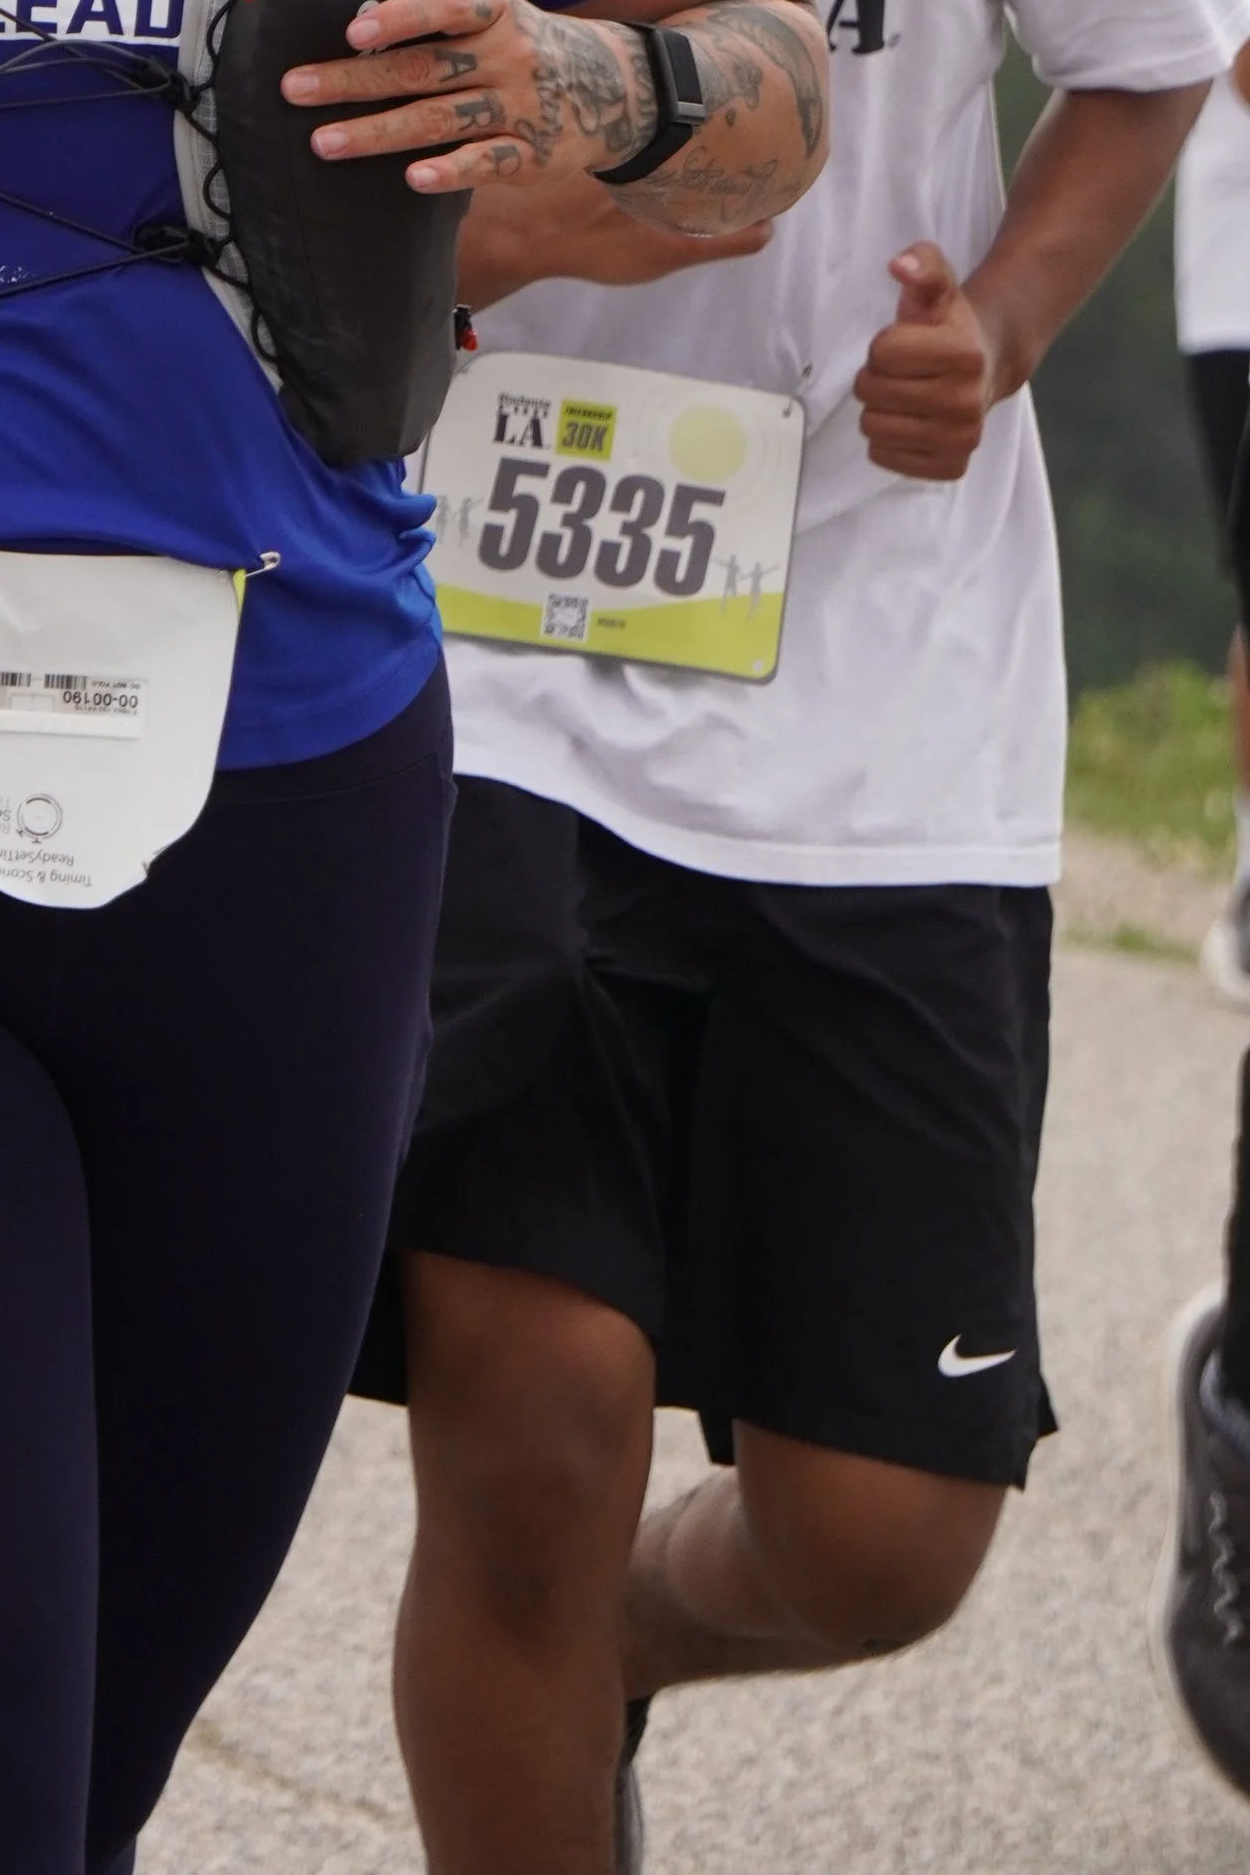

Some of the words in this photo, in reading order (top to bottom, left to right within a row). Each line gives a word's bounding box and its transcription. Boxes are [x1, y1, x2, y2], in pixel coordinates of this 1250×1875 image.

[493, 413, 542, 448] LA
[562, 420, 609, 452] 30K
[477, 457, 727, 597] 5335
[62, 690, 139, 709] 00-00190
[37, 872, 47, 884] &
[51, 869, 93, 888] Timing
